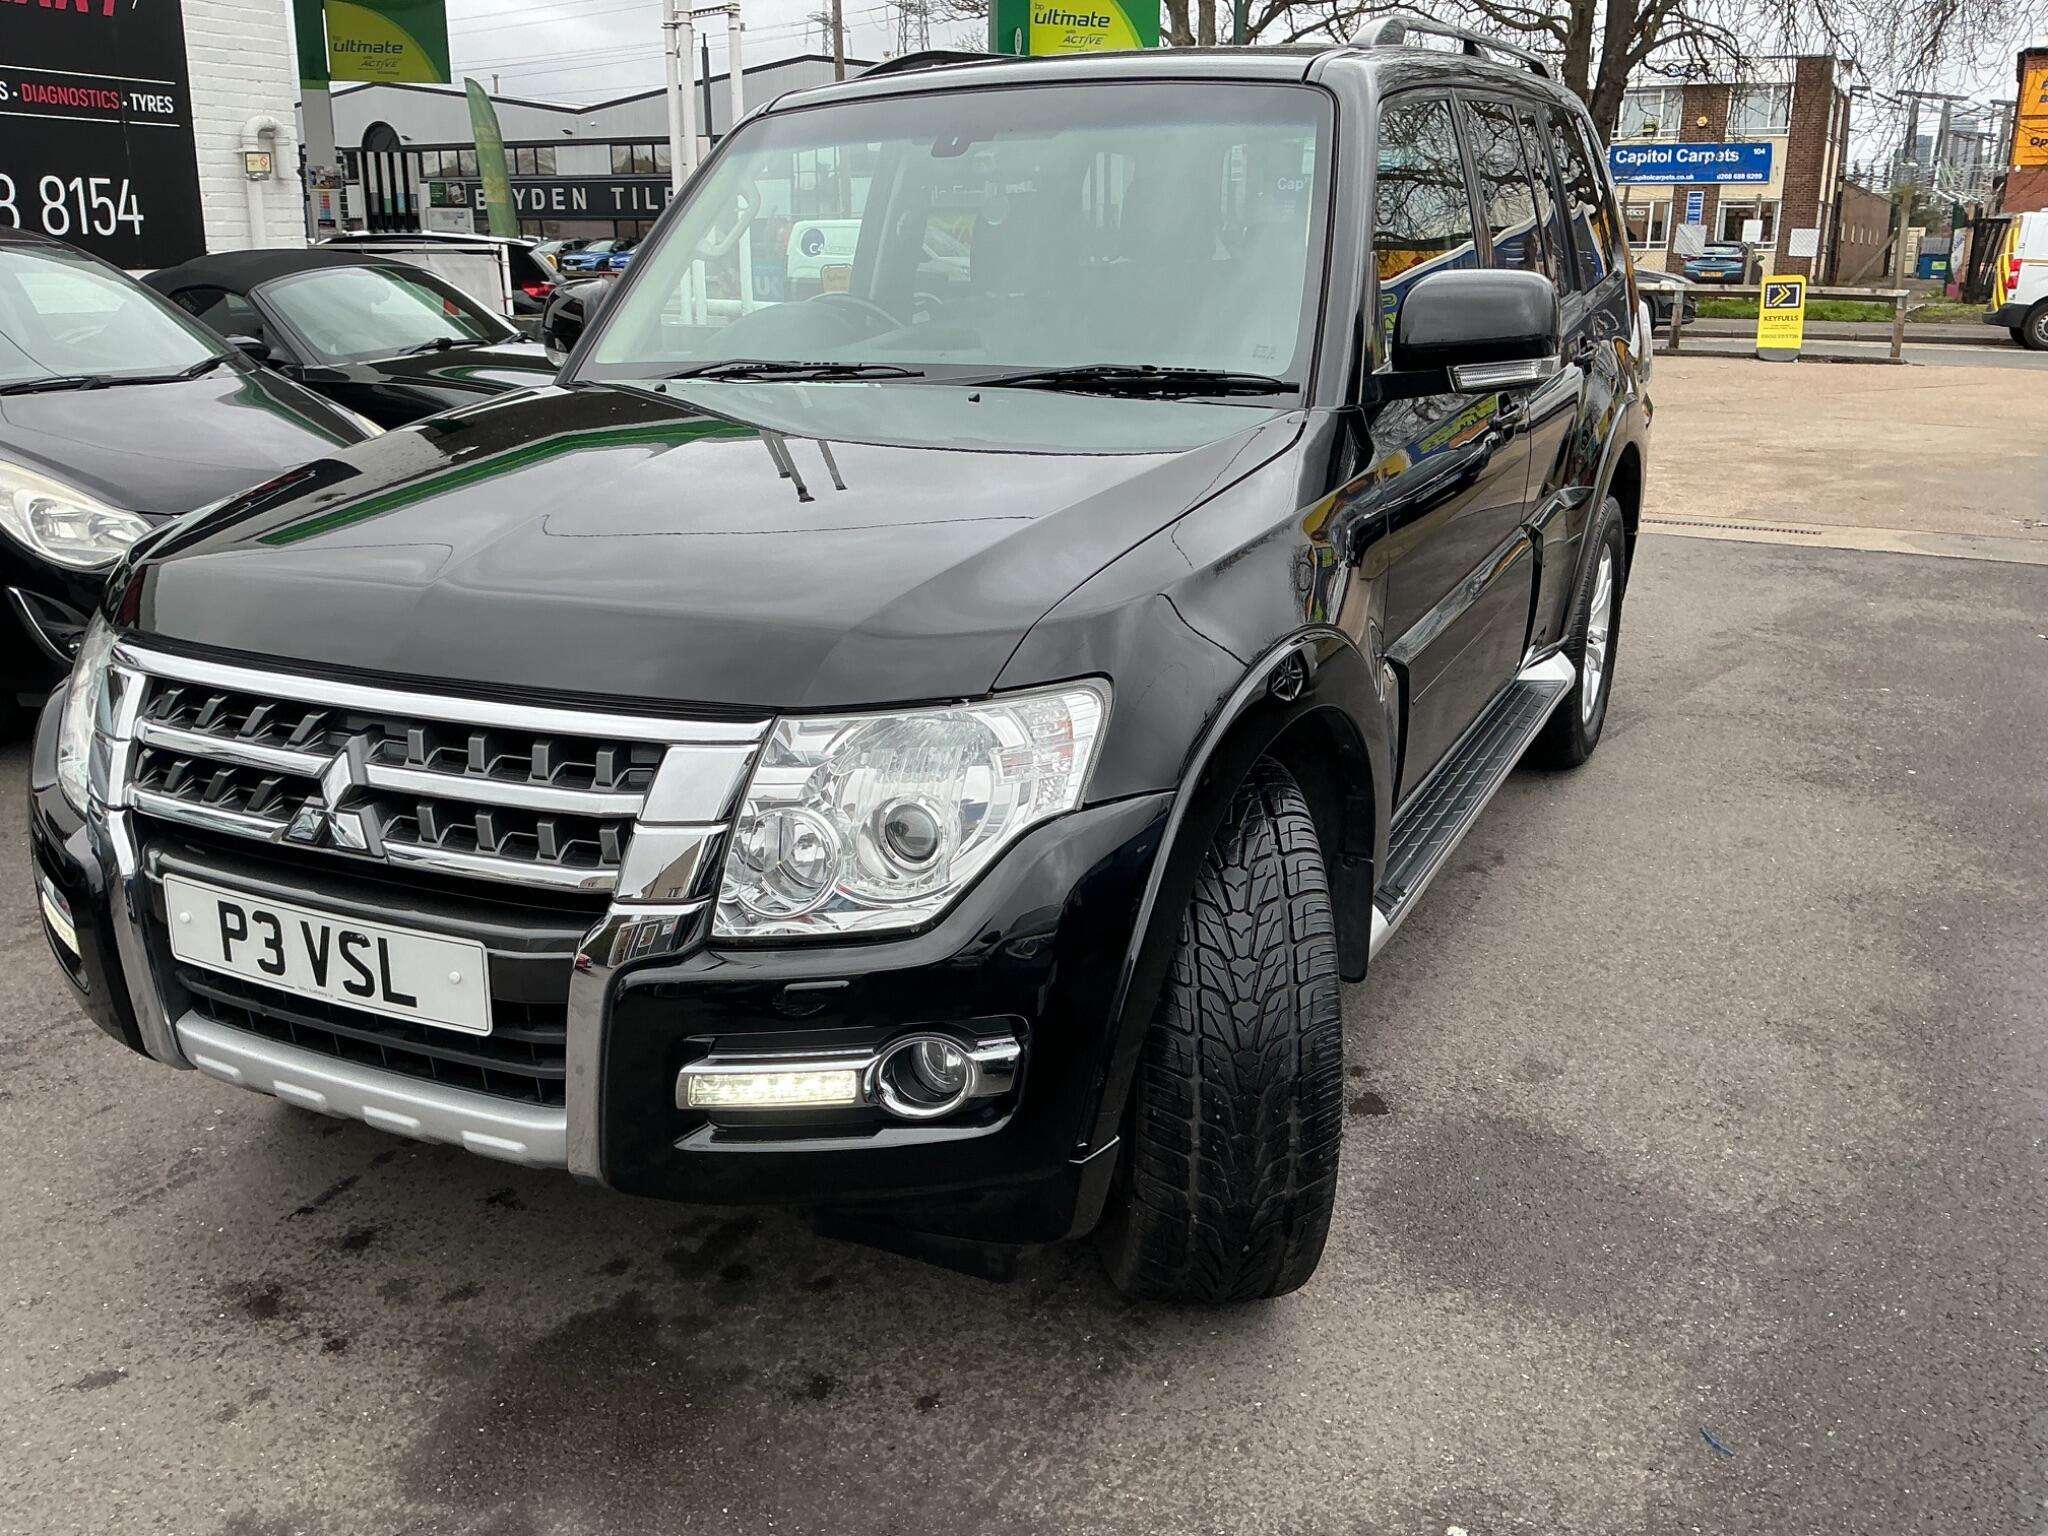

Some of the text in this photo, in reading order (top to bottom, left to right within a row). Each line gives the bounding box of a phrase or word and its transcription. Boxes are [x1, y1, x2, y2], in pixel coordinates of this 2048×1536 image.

[1034, 9, 1111, 28] ultimate
[333, 40, 404, 54] ultimate
[1062, 35, 1104, 46] ACTIVE
[21, 83, 120, 110] DIAGNOSTICS
[129, 93, 174, 114] TYRES
[1615, 148, 1740, 166] Capitol Carpets
[40, 175, 144, 236] 8154
[475, 187, 587, 211] BYDEN
[217, 900, 418, 1009] P3 VSL
